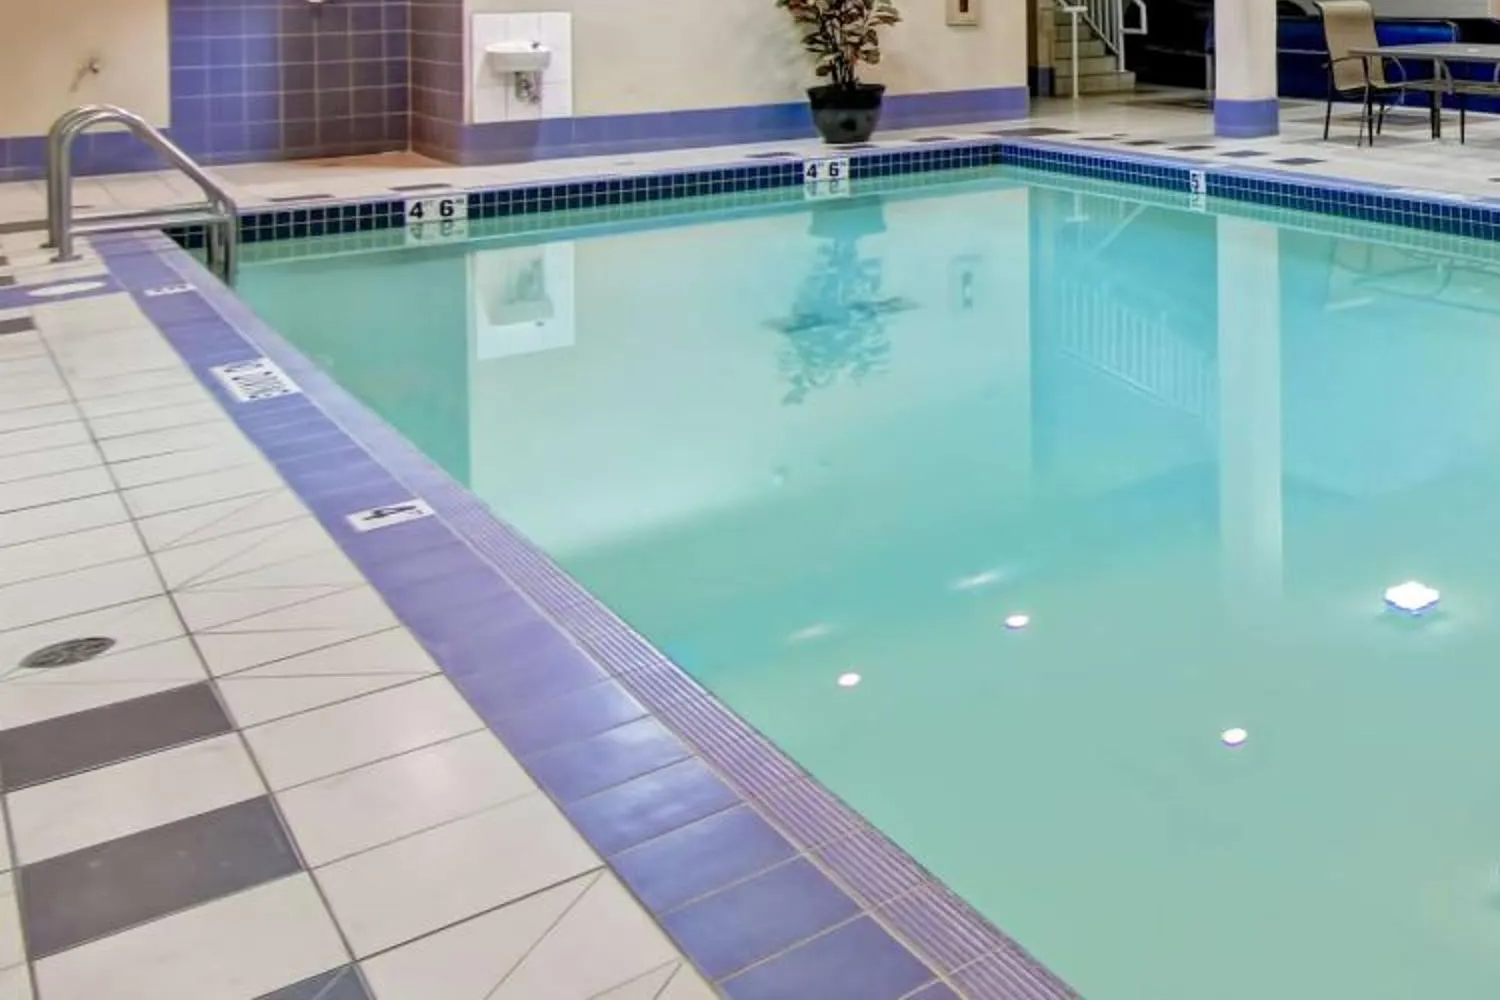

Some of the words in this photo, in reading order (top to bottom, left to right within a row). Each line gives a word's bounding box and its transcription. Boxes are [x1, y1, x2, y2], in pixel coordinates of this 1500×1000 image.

[806, 163, 817, 178] 4
[829, 161, 839, 177] 6
[409, 201, 423, 218] 4
[439, 199, 454, 217] 6
